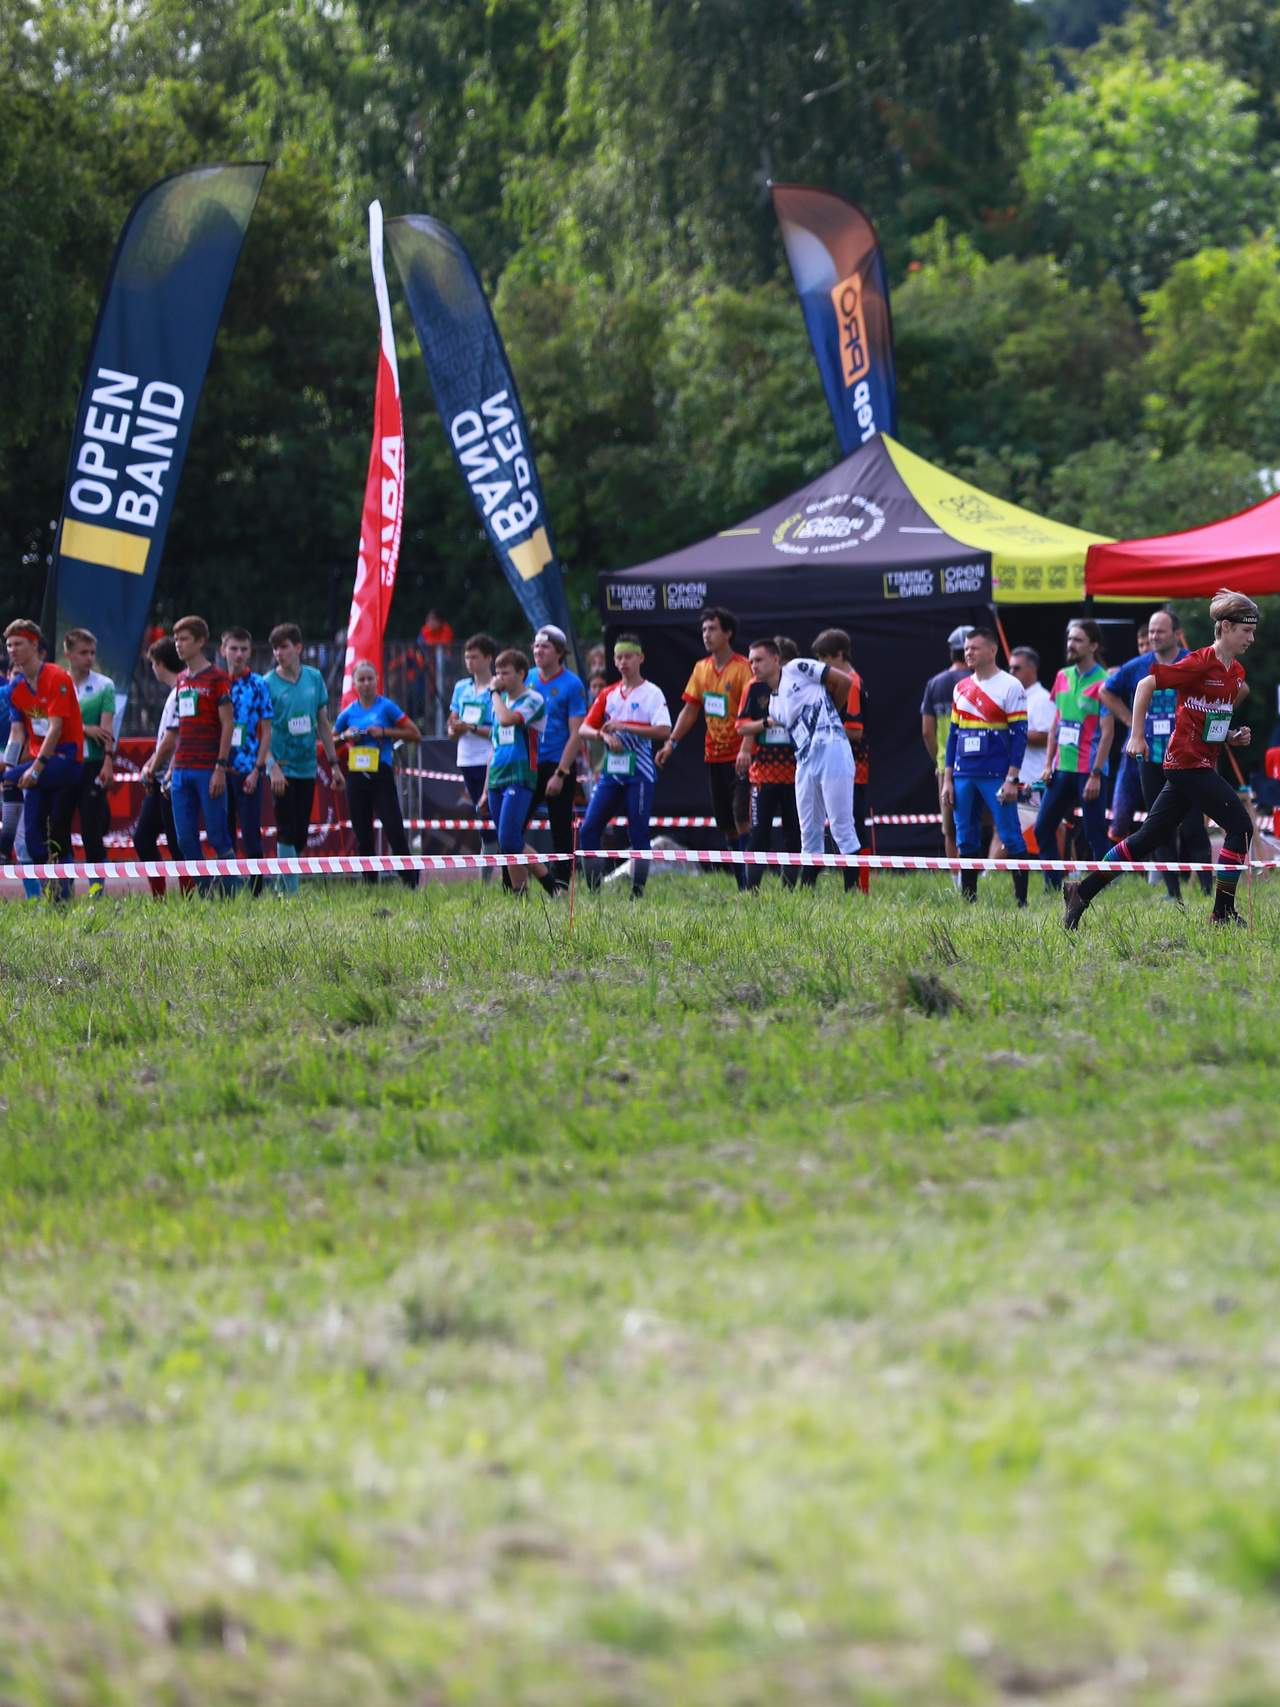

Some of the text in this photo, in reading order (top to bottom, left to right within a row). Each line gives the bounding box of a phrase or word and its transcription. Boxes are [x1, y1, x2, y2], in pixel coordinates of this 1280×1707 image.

[70, 368, 139, 515] OPEN
[115, 381, 185, 527] BAND
[666, 582, 707, 598] OPEN
[944, 563, 986, 581] OPEN
